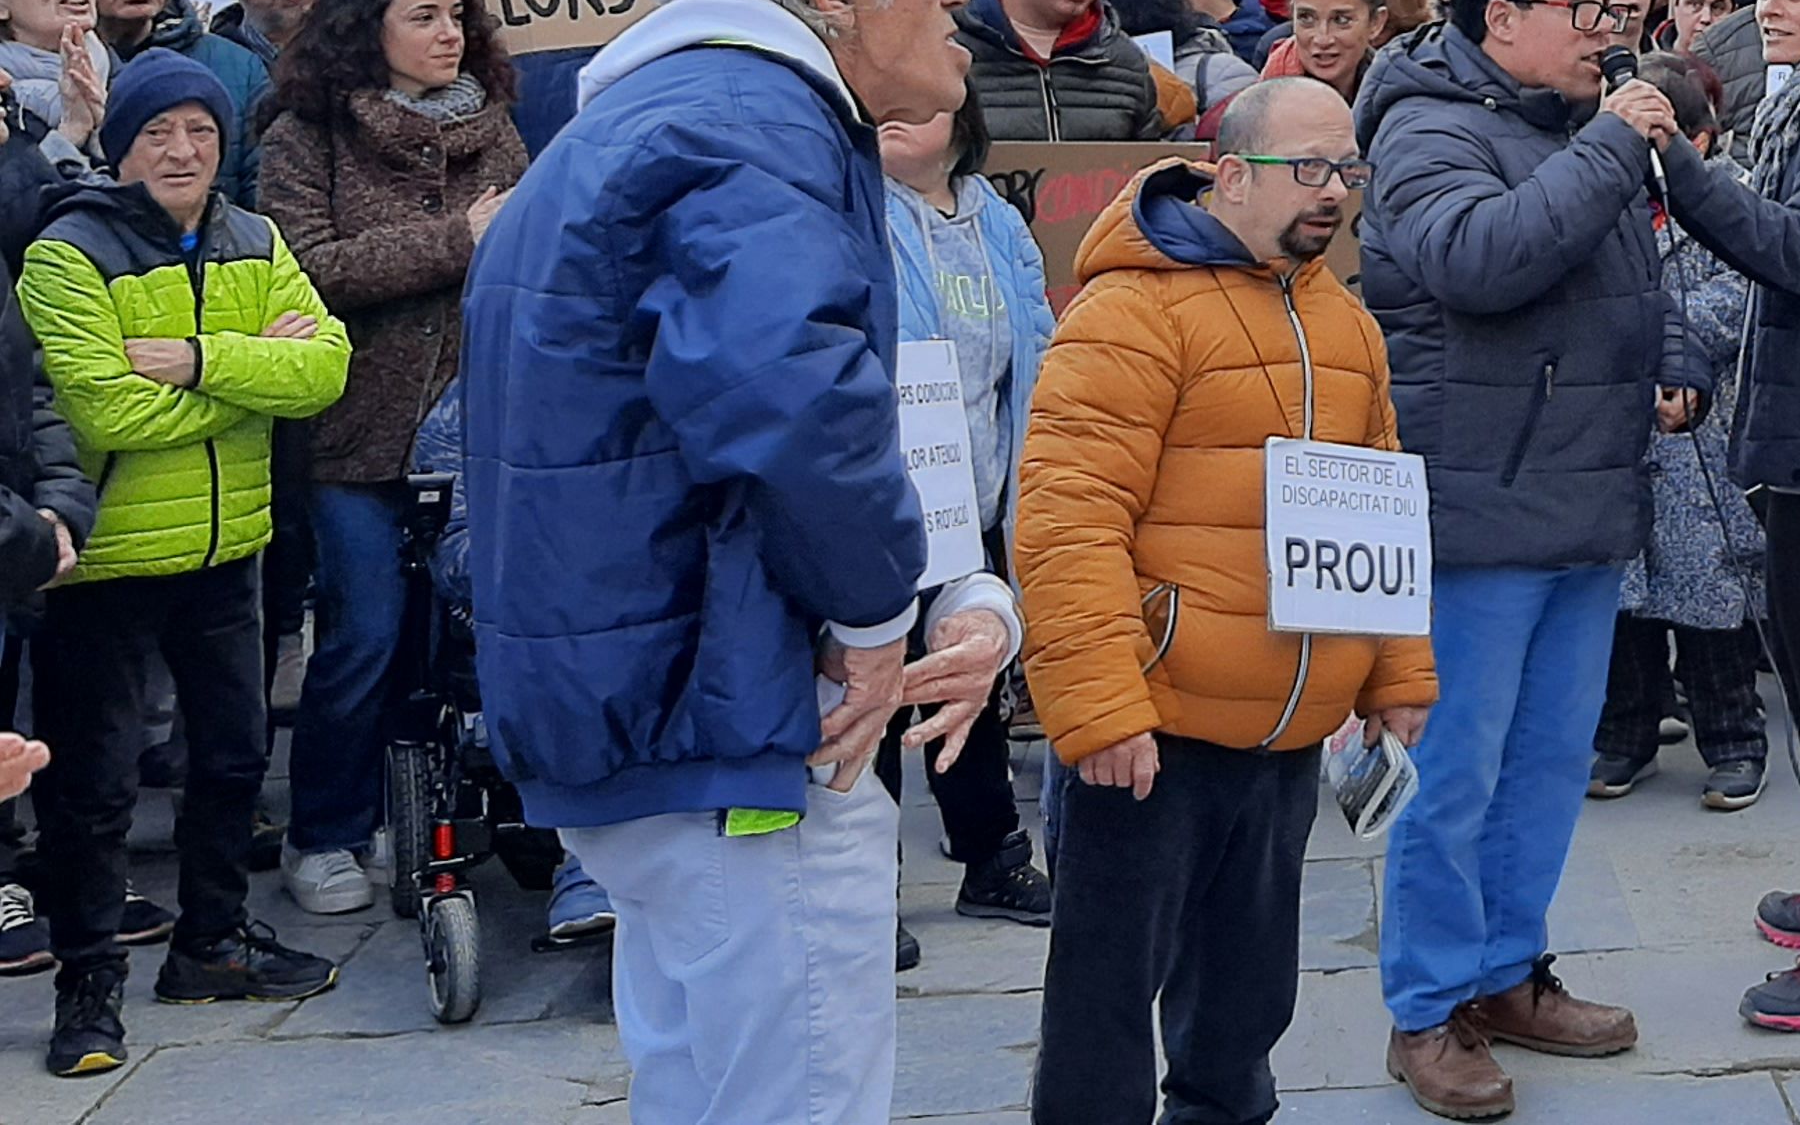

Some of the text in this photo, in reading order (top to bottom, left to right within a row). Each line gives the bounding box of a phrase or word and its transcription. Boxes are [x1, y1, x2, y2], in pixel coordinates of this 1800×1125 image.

[1285, 455, 1414, 490] EL SECTOR DE LA
[1282, 484, 1418, 517] DISCAPACITAT DIU
[1285, 536, 1416, 597] PROU!
